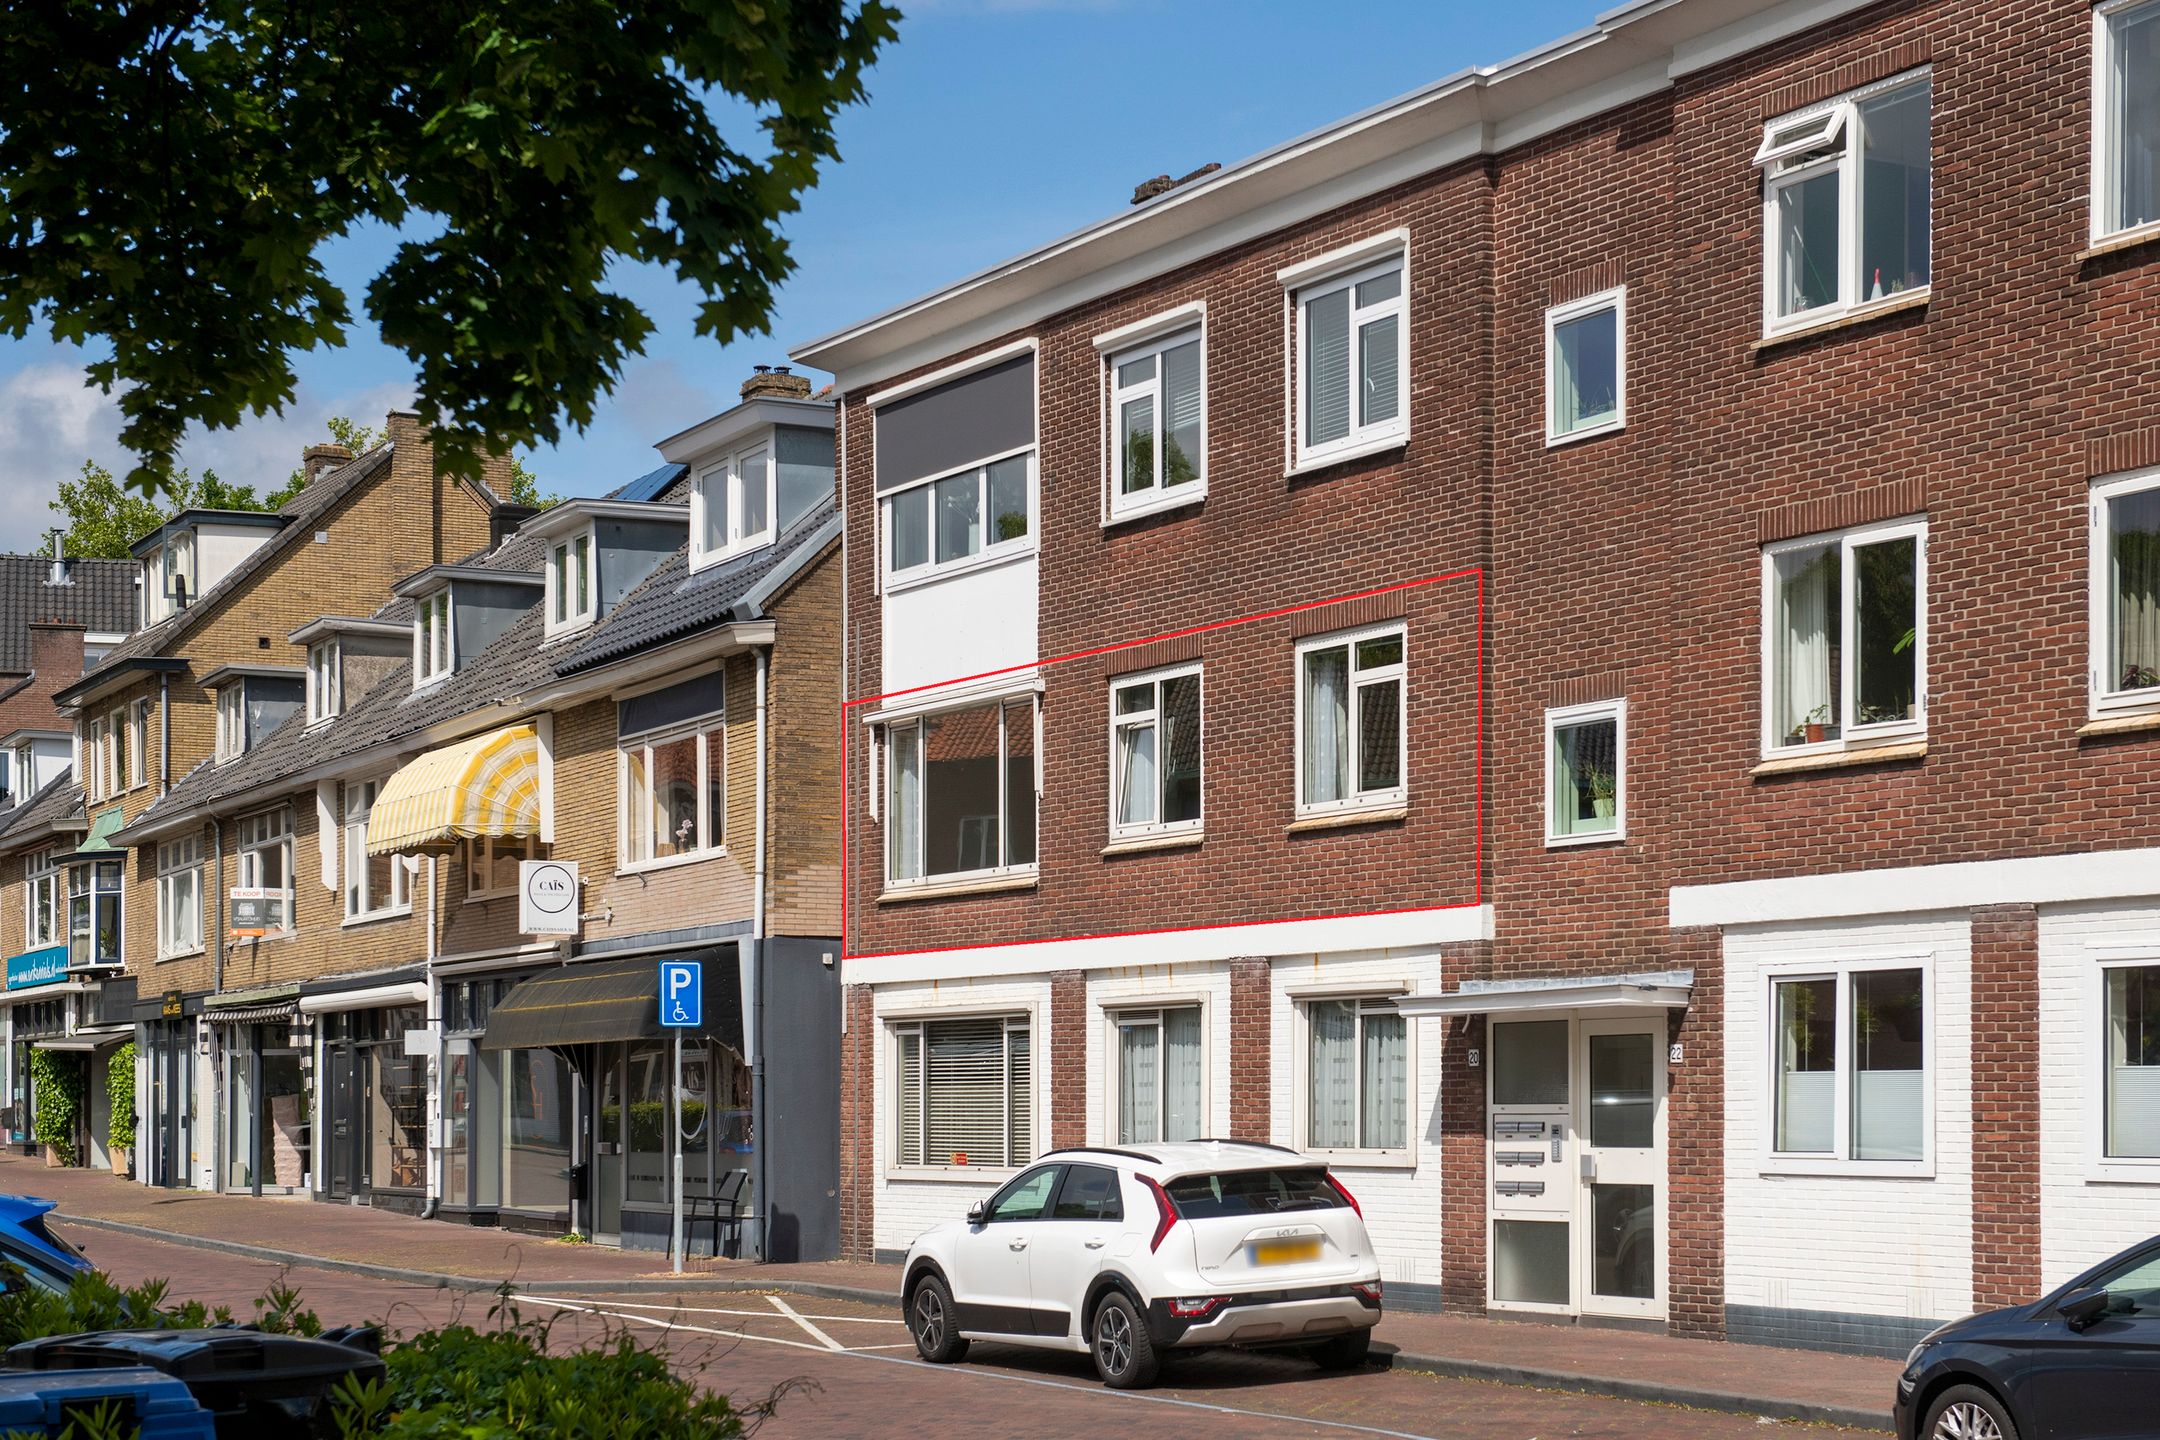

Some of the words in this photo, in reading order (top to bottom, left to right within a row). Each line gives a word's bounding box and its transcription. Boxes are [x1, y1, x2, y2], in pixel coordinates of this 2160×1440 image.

[539, 879, 564, 891] CAÏS
[670, 968, 692, 1000] P
[1469, 1051, 1479, 1064] 20
[1671, 1047, 1681, 1060] 22
[1276, 1228, 1299, 1238] KIA
